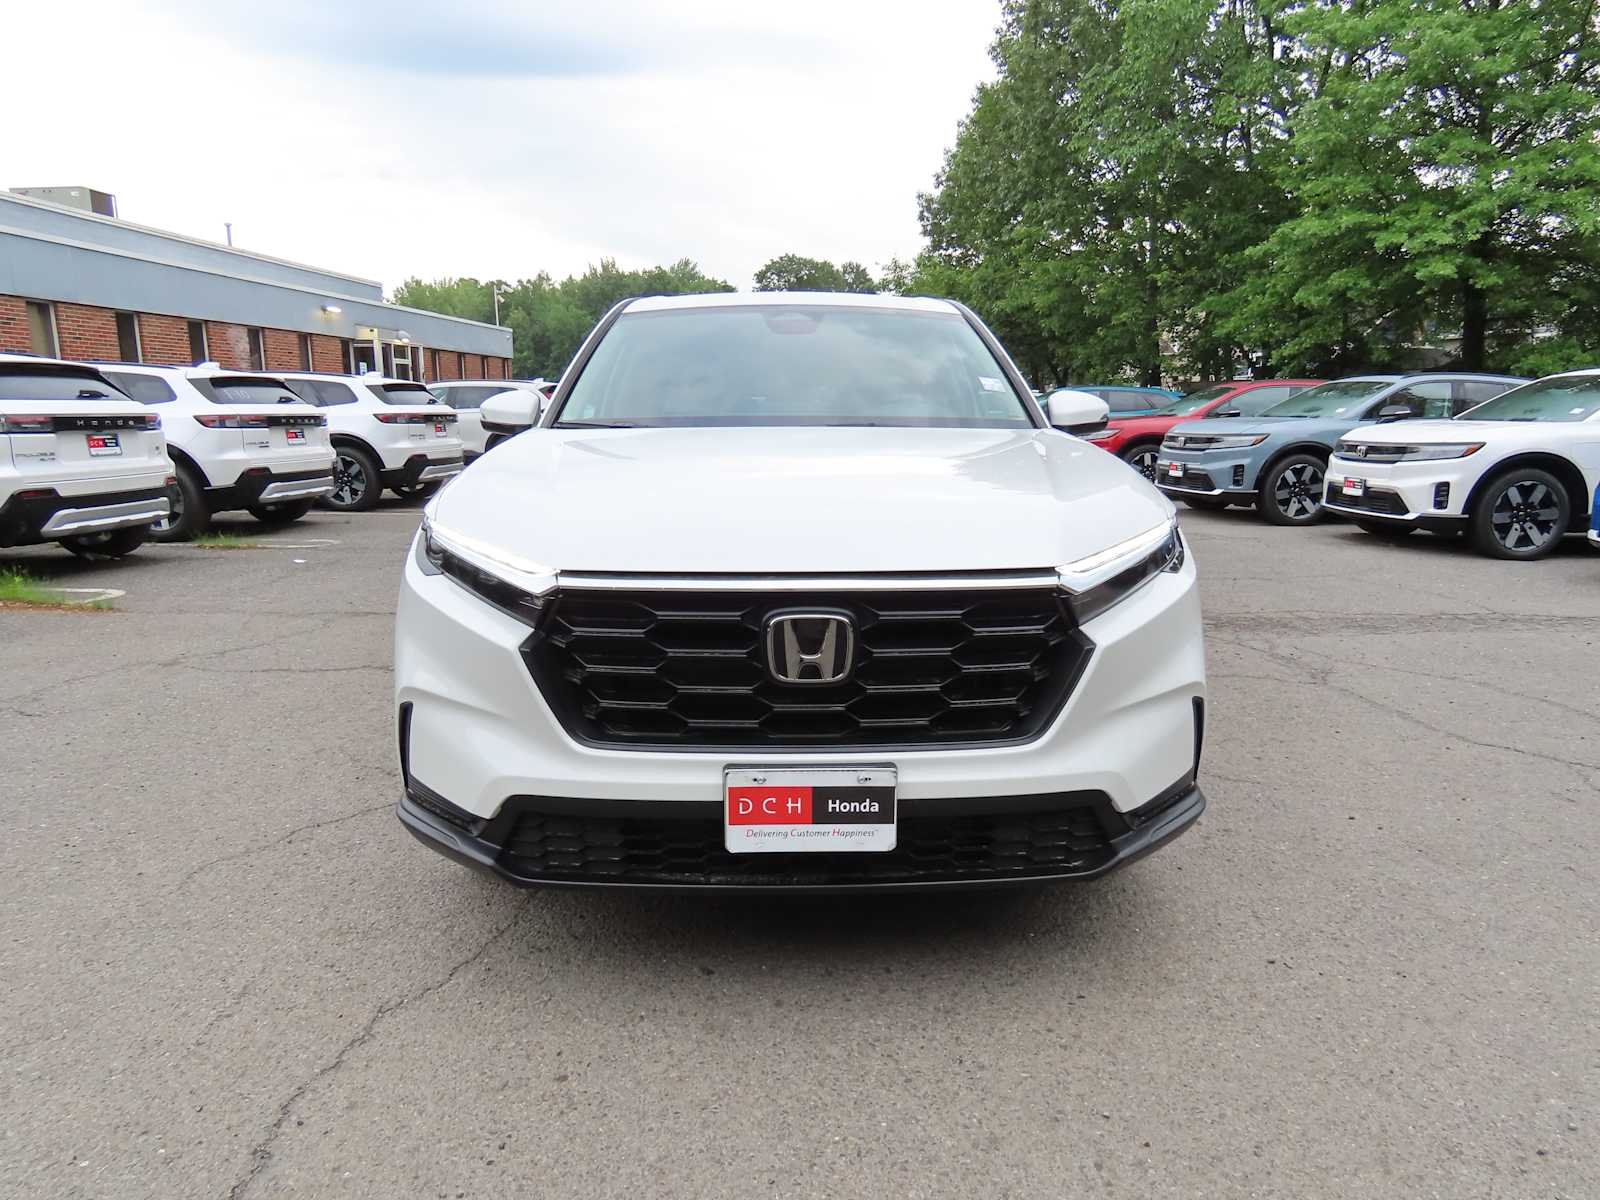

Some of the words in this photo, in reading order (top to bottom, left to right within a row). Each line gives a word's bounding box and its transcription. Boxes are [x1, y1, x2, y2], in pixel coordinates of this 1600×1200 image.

[827, 798, 880, 813] Honda
[746, 828, 789, 839] Delivering
[790, 829, 830, 838] Customer
